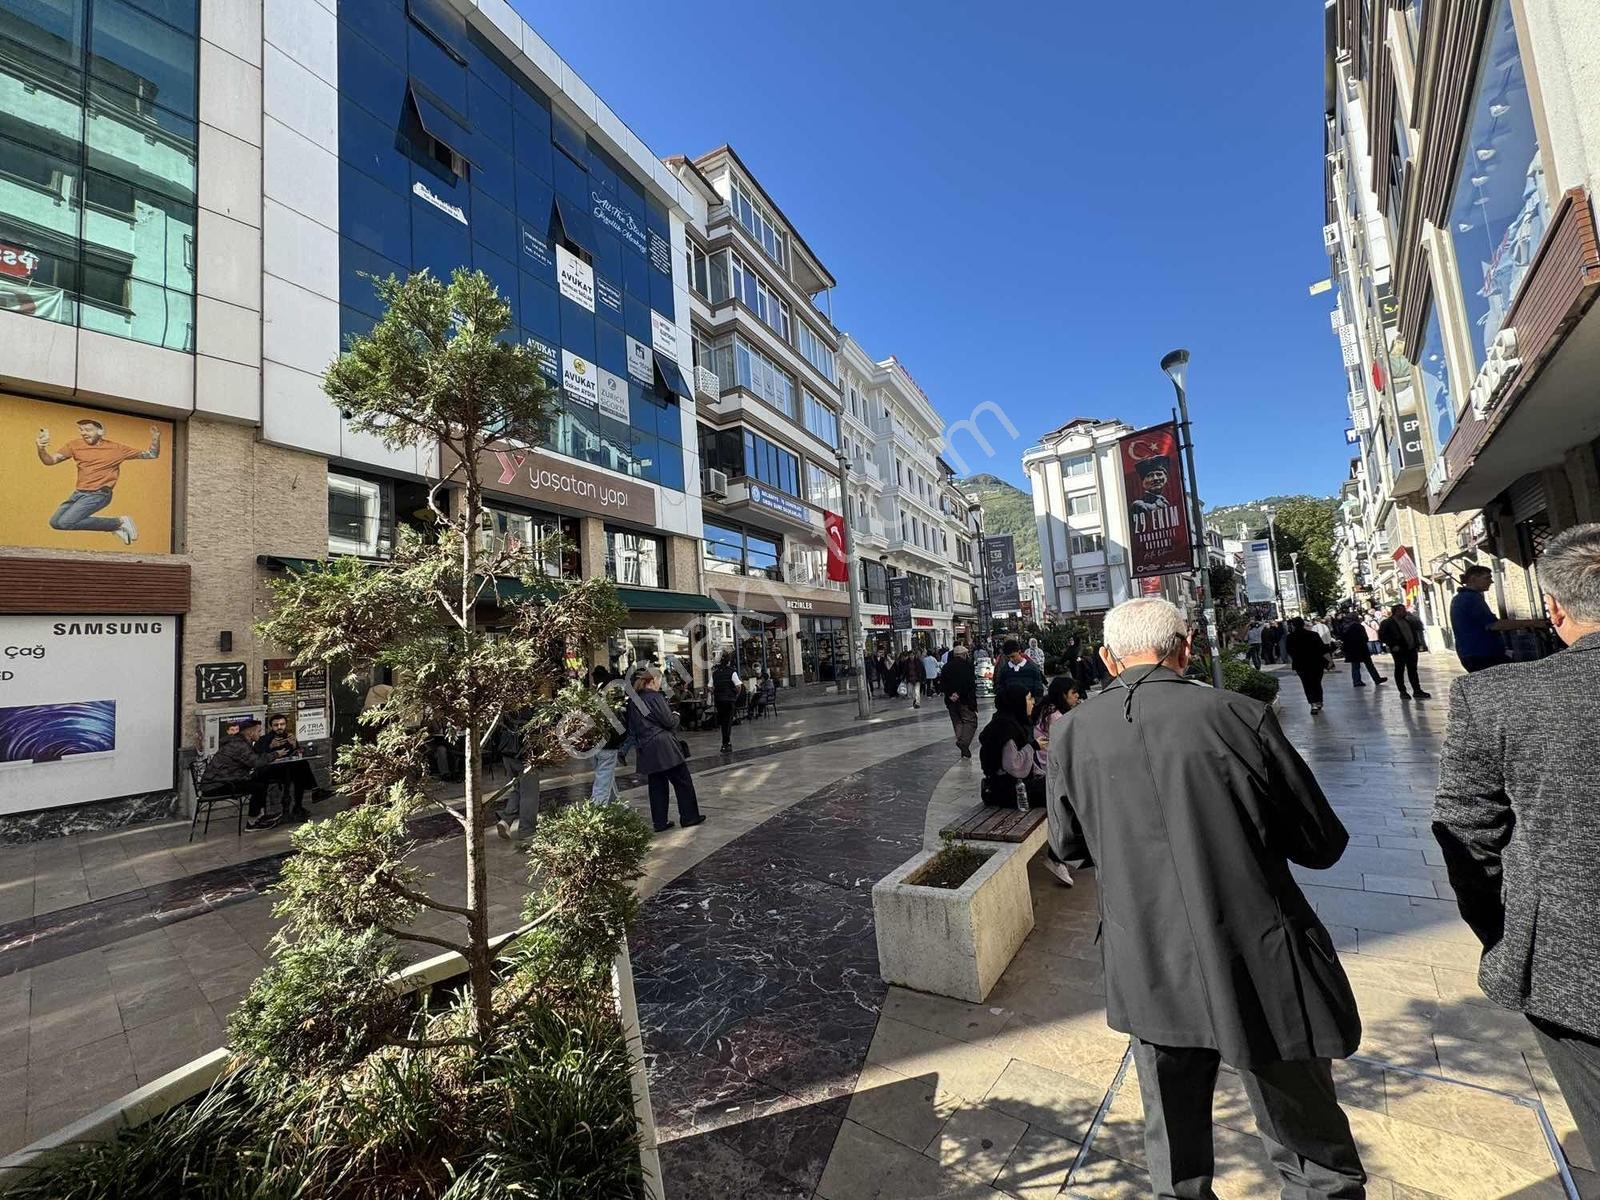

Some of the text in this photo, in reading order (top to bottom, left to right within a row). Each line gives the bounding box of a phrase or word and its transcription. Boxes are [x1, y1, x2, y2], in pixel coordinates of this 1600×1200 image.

[561, 270, 592, 294] AVUKAT
[527, 337, 557, 359] AVUKAT
[564, 369, 596, 391] AVUKAT
[529, 467, 629, 510] yaşatan yapı
[1132, 505, 1180, 534] 29 EKİM
[53, 622, 162, 636] SAMSUNG
[4, 645, 46, 659] Çağ
[0, 671, 14, 681] D
